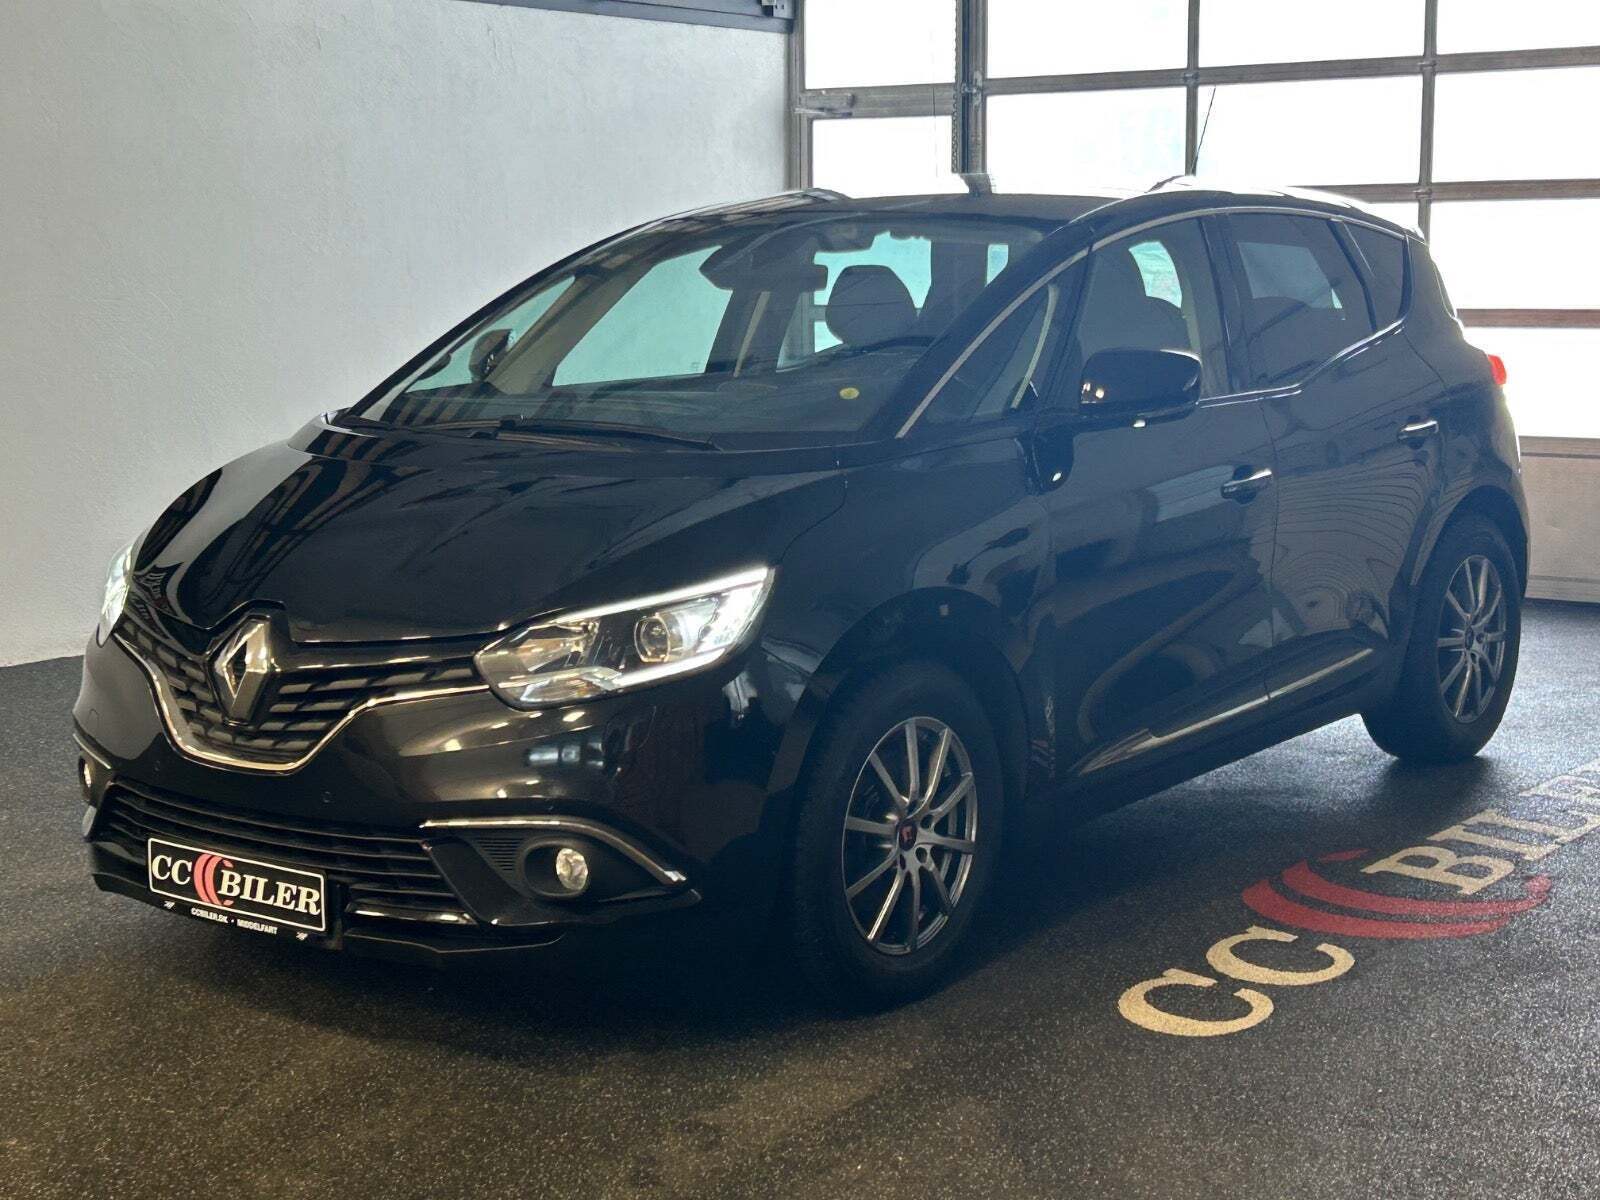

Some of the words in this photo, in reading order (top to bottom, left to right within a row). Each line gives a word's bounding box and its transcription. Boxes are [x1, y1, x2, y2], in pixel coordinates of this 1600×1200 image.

[152, 855, 192, 885] CC
[217, 869, 321, 915] BILER
[1118, 925, 1355, 1037] CC
